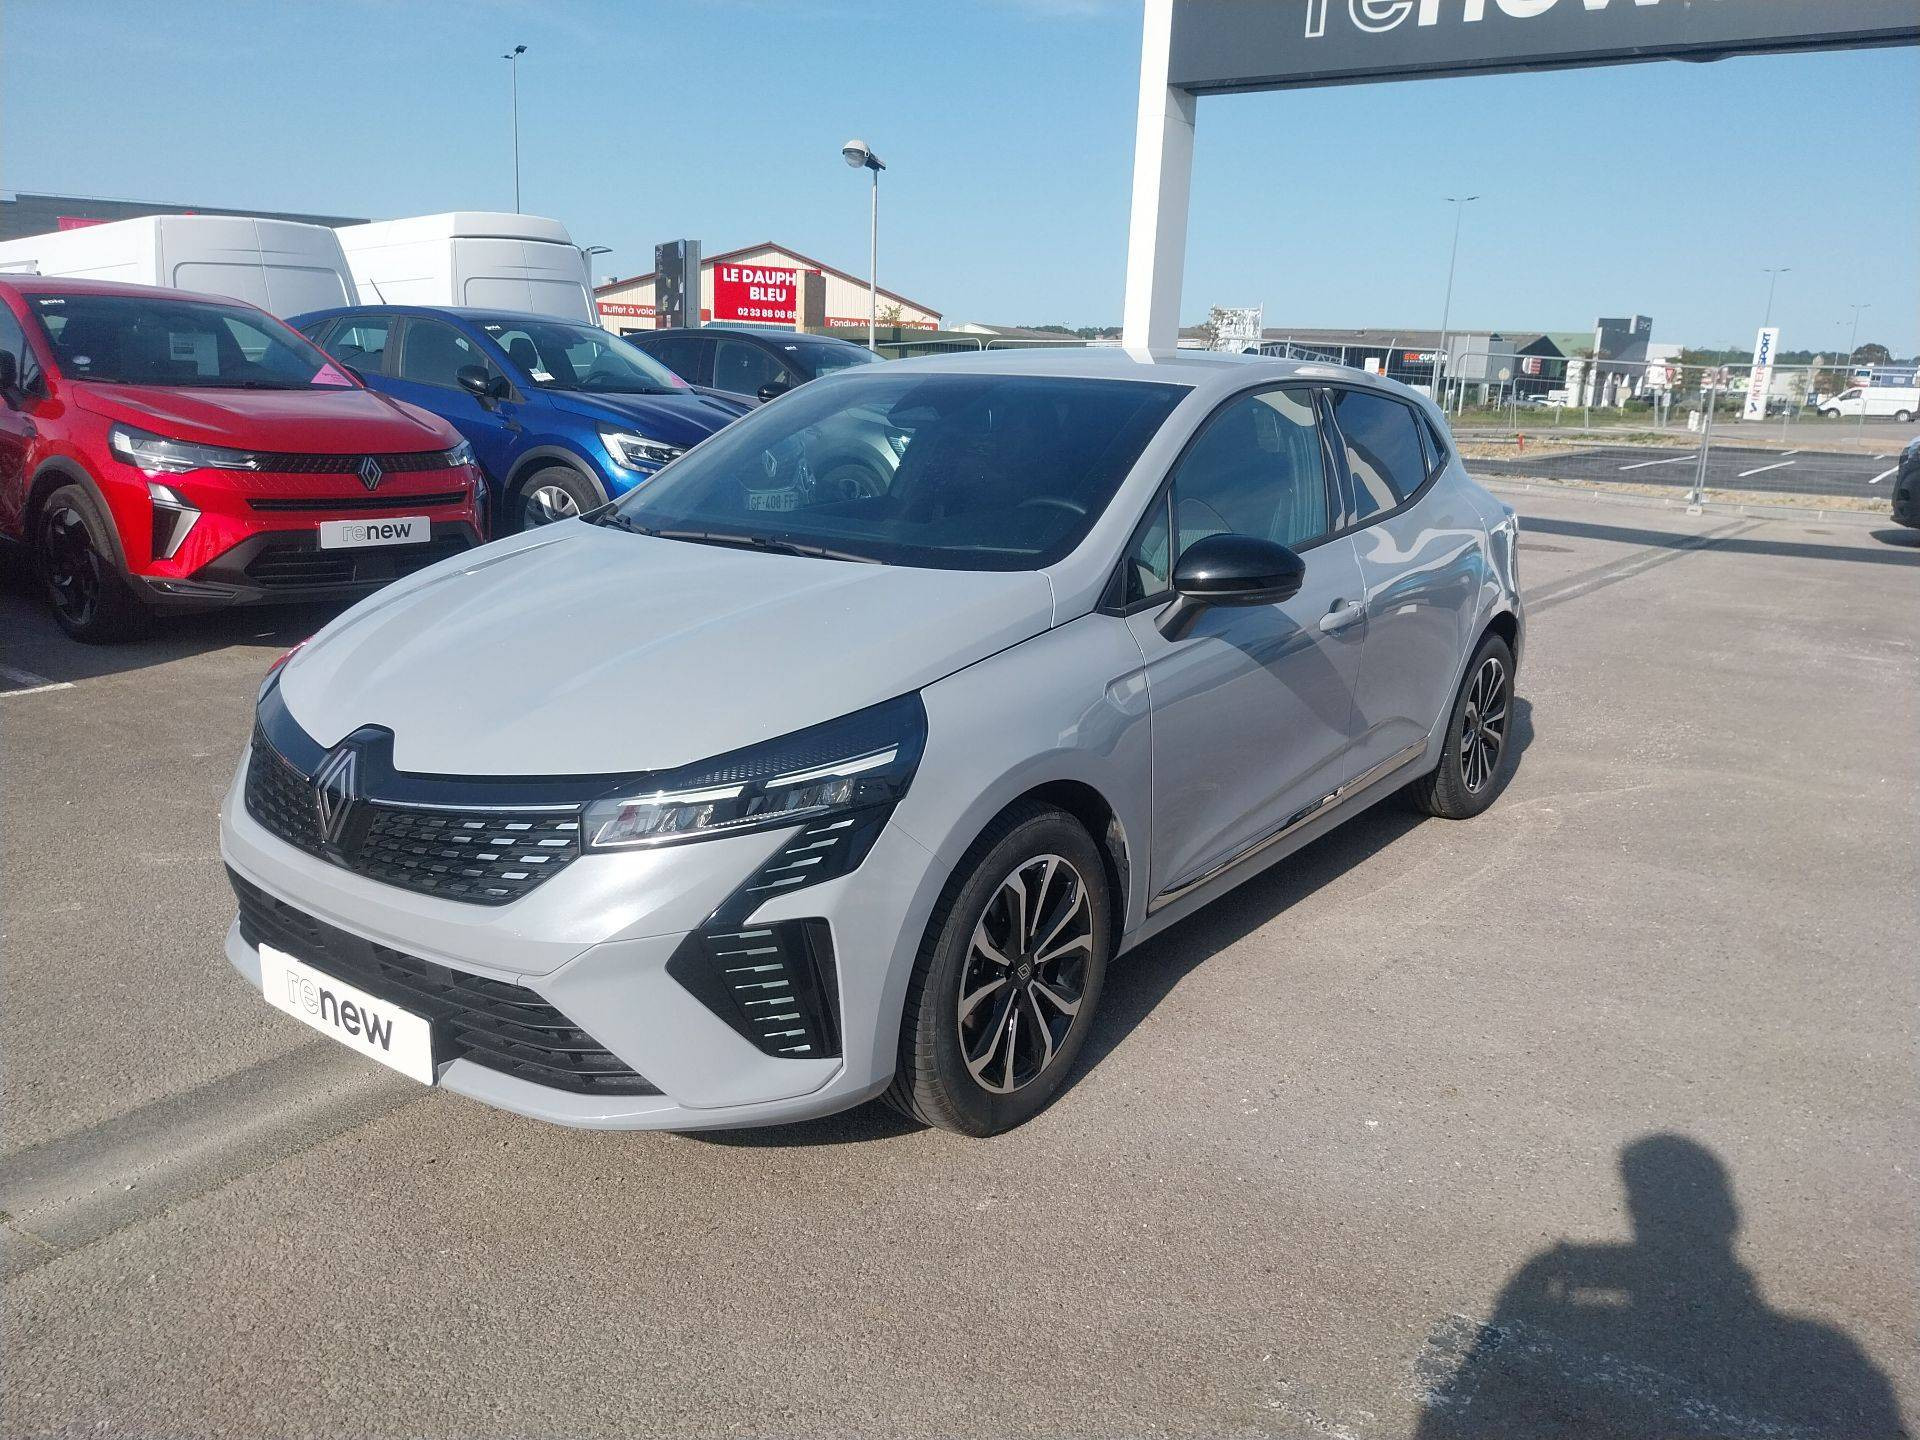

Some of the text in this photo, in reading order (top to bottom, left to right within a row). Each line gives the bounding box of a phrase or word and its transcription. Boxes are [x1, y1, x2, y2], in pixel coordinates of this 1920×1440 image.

[723, 267, 797, 286] LE DAUPH
[749, 286, 787, 302] BLEU
[602, 304, 627, 314] Buffet
[636, 307, 656, 315] volo
[737, 307, 749, 316] 02
[749, 308, 761, 317] 33
[829, 318, 858, 328] Fondue
[342, 523, 412, 542] renew
[286, 969, 393, 1052] renew
